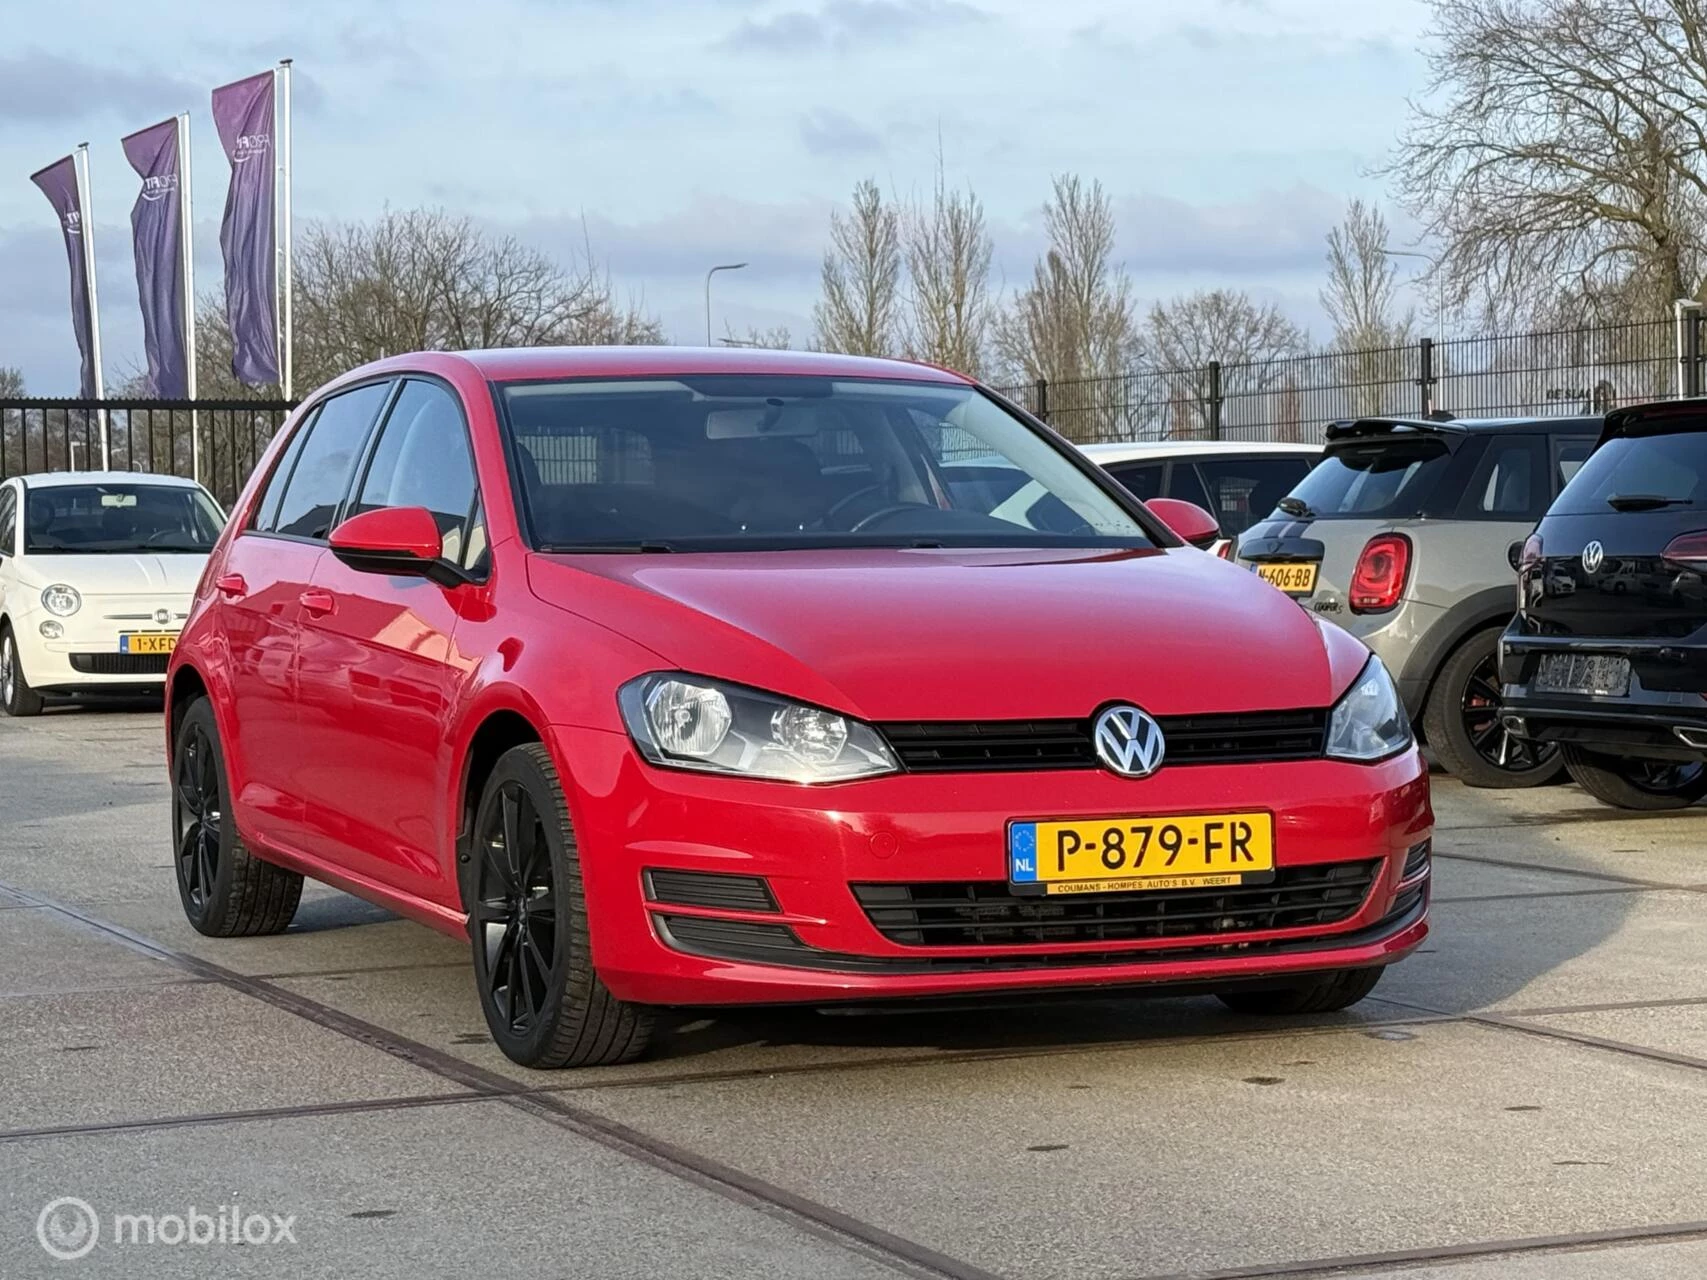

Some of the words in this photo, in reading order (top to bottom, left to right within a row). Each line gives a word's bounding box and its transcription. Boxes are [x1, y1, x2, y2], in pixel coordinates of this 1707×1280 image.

[1057, 821, 1254, 872] P-879-FR
[1015, 857, 1034, 873] NL
[1202, 876, 1232, 886] WEERT
